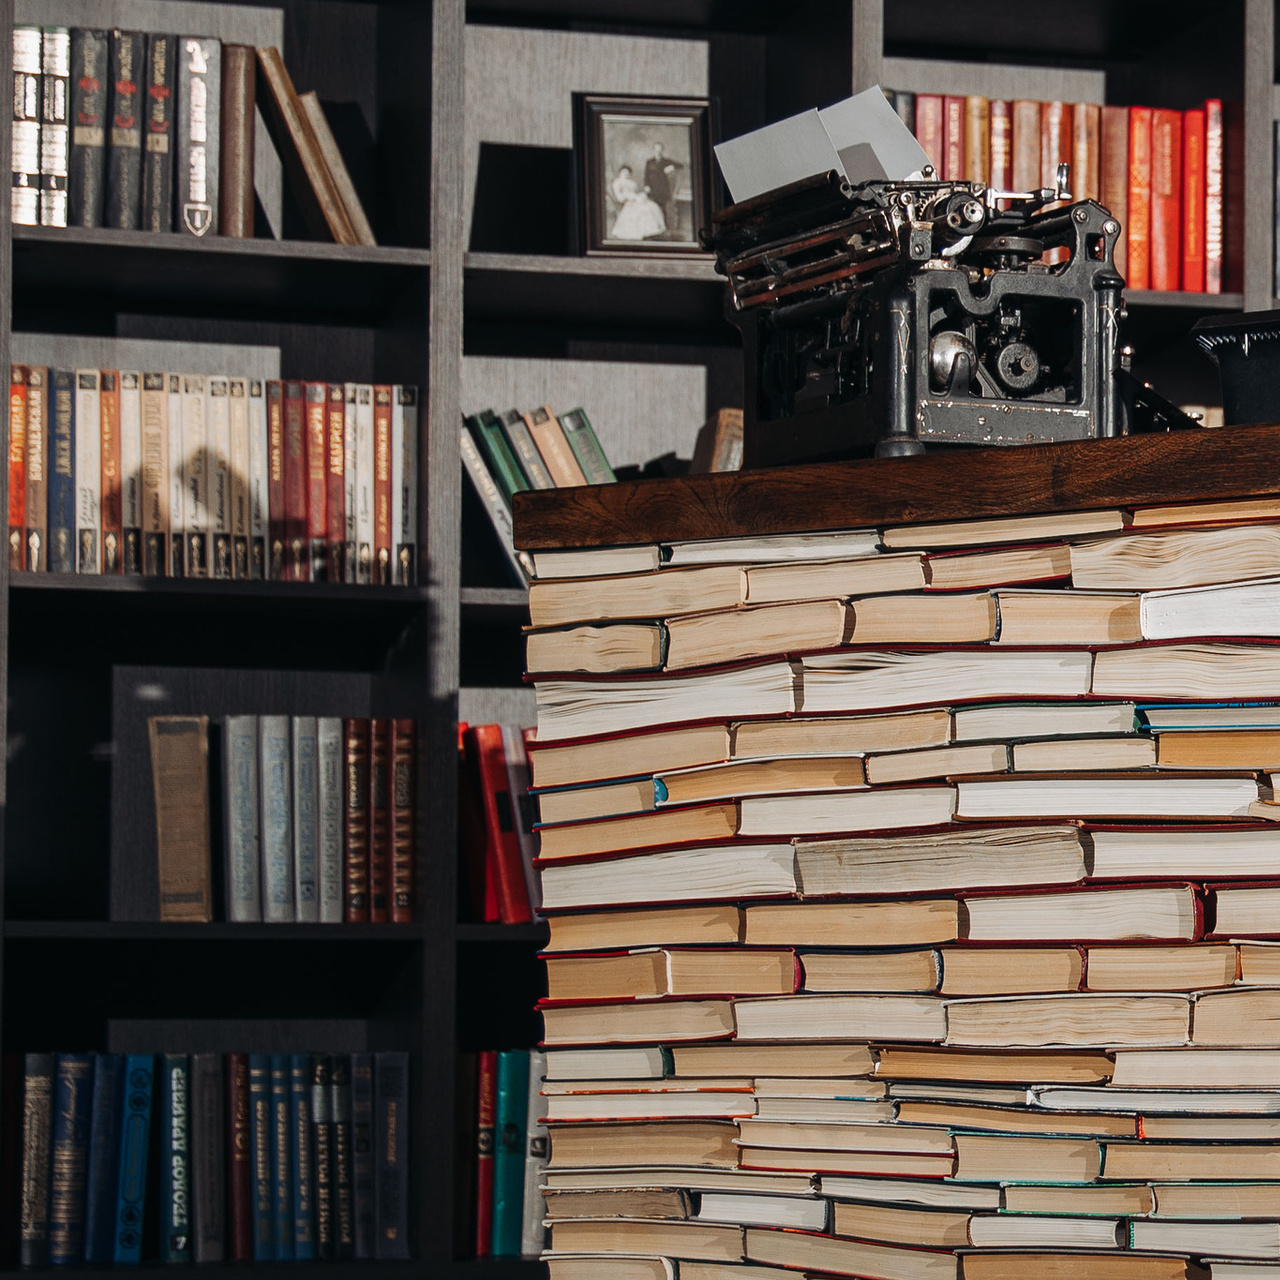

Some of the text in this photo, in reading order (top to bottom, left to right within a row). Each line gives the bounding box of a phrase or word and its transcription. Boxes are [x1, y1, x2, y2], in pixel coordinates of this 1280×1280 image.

[330, 411, 343, 476] АНДЕРСЕН
[171, 1067, 187, 1227] ТЕОДОР ДРАЙЗЕР
